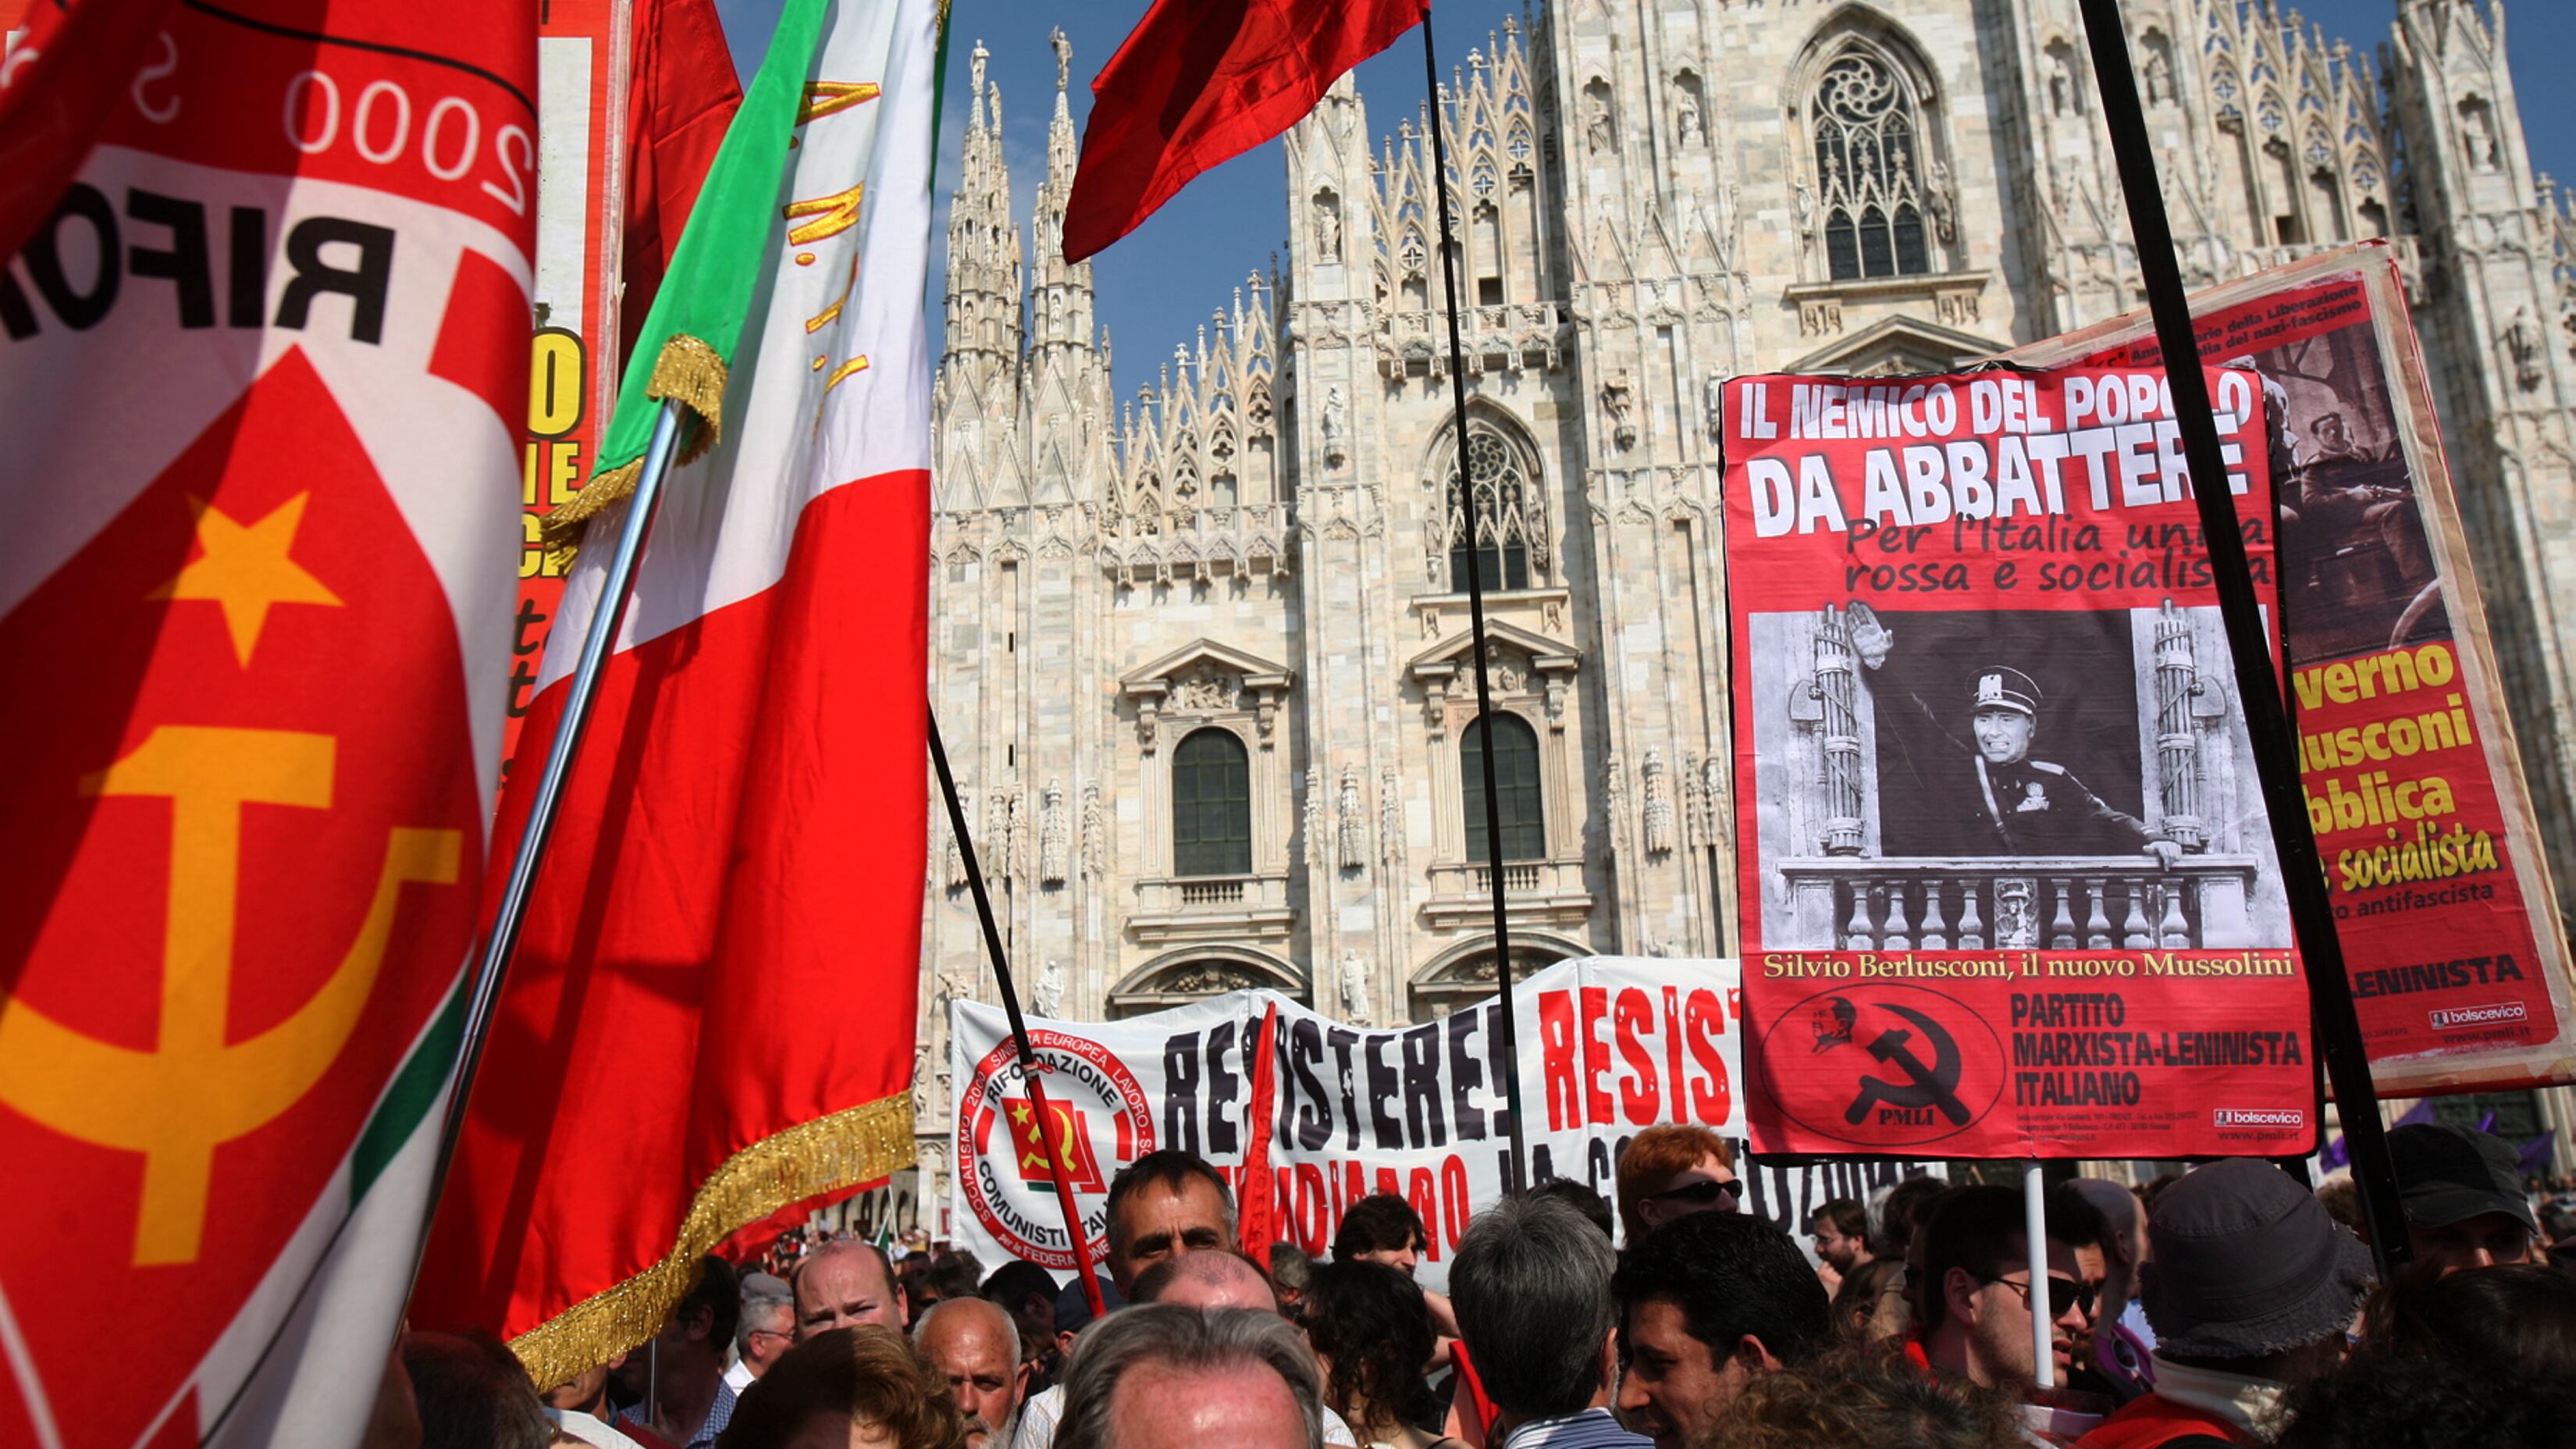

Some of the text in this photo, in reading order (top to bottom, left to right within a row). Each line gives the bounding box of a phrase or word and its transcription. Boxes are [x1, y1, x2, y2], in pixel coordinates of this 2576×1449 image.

[2226, 313, 2263, 333] della
[2266, 285, 2359, 320] Liberazione
[2253, 299, 2363, 340] nazi-fascismo
[1740, 383, 1777, 439] IL
[1791, 383, 1957, 440] NEMICO
[1969, 379, 2051, 435] DEL
[1746, 414, 2248, 538] DA ABBATTERE
[1847, 511, 2267, 554] Per l'Italia unia
[1846, 547, 2271, 592] rossa e socialisa
[2293, 645, 2454, 710] verno
[2338, 821, 2498, 892] socialista
[2357, 883, 2494, 917] antifascista
[1763, 952, 2294, 981] Silvio Berlusconi, il nuovo Mussolini
[2010, 993, 2126, 1028] PARTITO
[2450, 1005, 2524, 1024] bolscevico
[1043, 1031, 1108, 1068] EUROPEA
[1538, 984, 1742, 1133] RESIS
[2012, 1031, 2303, 1067] MARXISTA-LENINISTA
[986, 1052, 1119, 1109] RIFODAZIONE
[1112, 1068, 1150, 1128] LAVORO
[2015, 1071, 2140, 1107] ITALIANO
[1877, 1109, 1934, 1127] PMLI
[2234, 1111, 2301, 1124] bolscevico
[960, 1070, 991, 1223] SOCIALISMO 2000
[979, 1160, 1067, 1247] COMUNISTI
